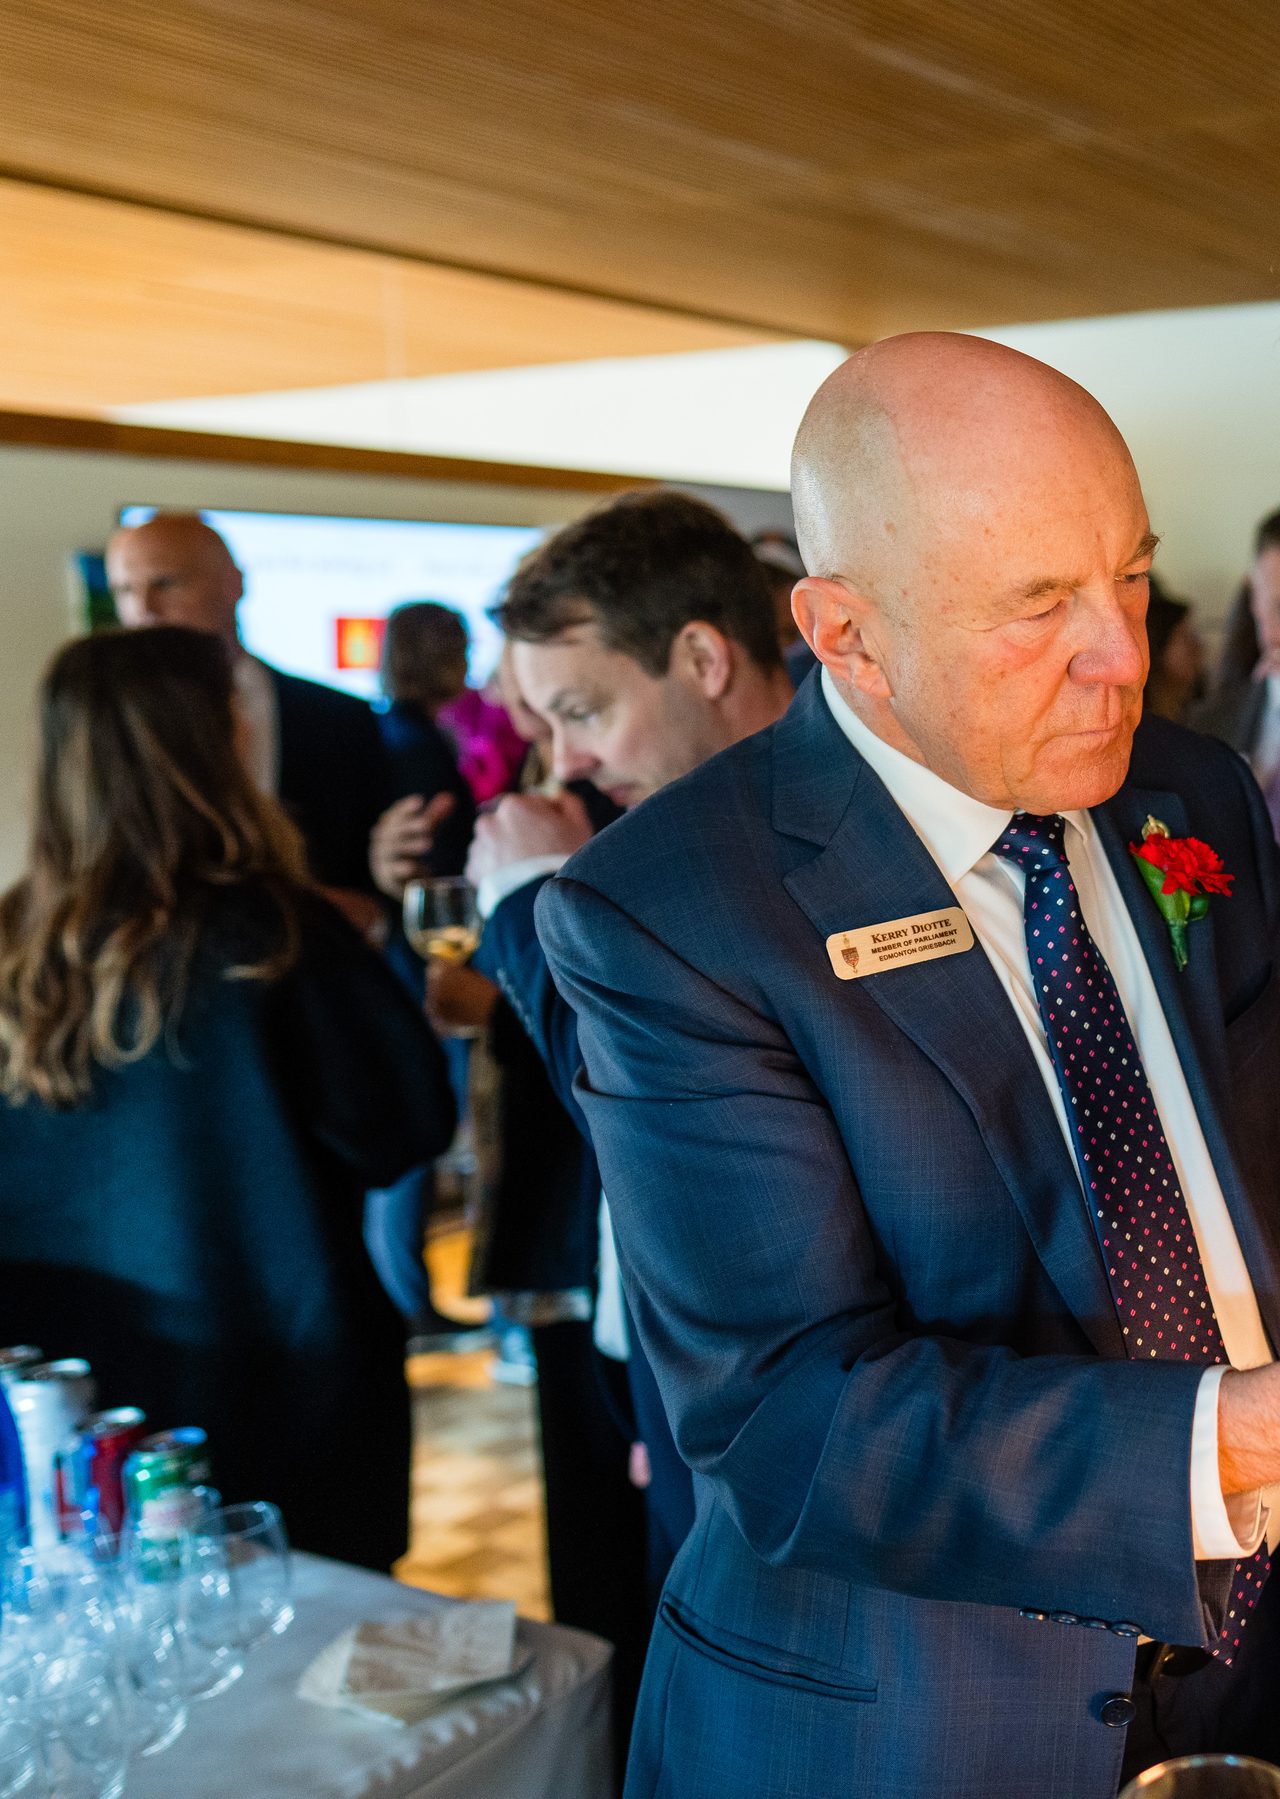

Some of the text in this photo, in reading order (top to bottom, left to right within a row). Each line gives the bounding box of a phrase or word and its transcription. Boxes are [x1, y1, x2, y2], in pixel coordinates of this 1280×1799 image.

[871, 929, 958, 954] MEMBER OF PARLIAMENT
[879, 938, 956, 962] EDMONTON GRIESBACH
